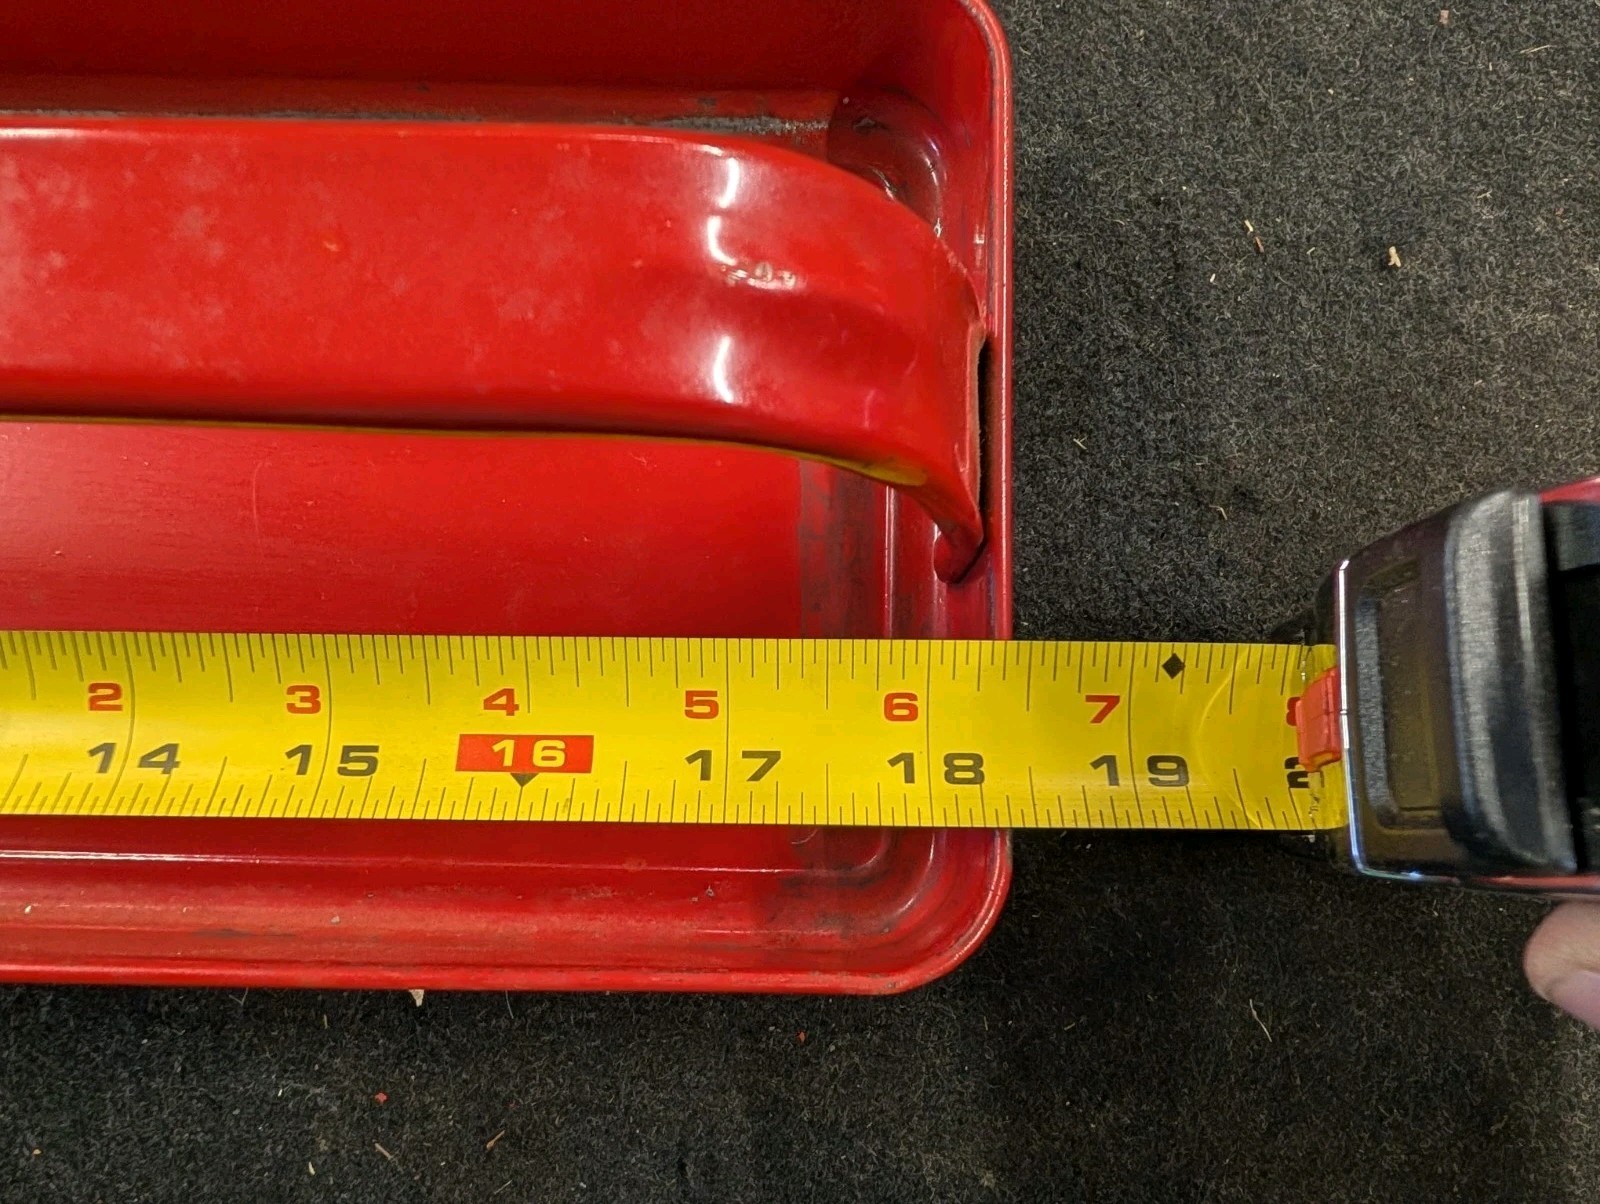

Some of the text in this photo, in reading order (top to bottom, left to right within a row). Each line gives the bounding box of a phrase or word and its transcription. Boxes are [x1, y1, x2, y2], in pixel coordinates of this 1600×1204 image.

[88, 682, 1120, 723] 2 3 4 5 6 7
[88, 742, 181, 775] 14
[285, 744, 380, 777] 15
[491, 739, 566, 767] 16
[685, 750, 781, 781] 17
[887, 752, 985, 784] 18
[1089, 755, 1190, 787] 19
